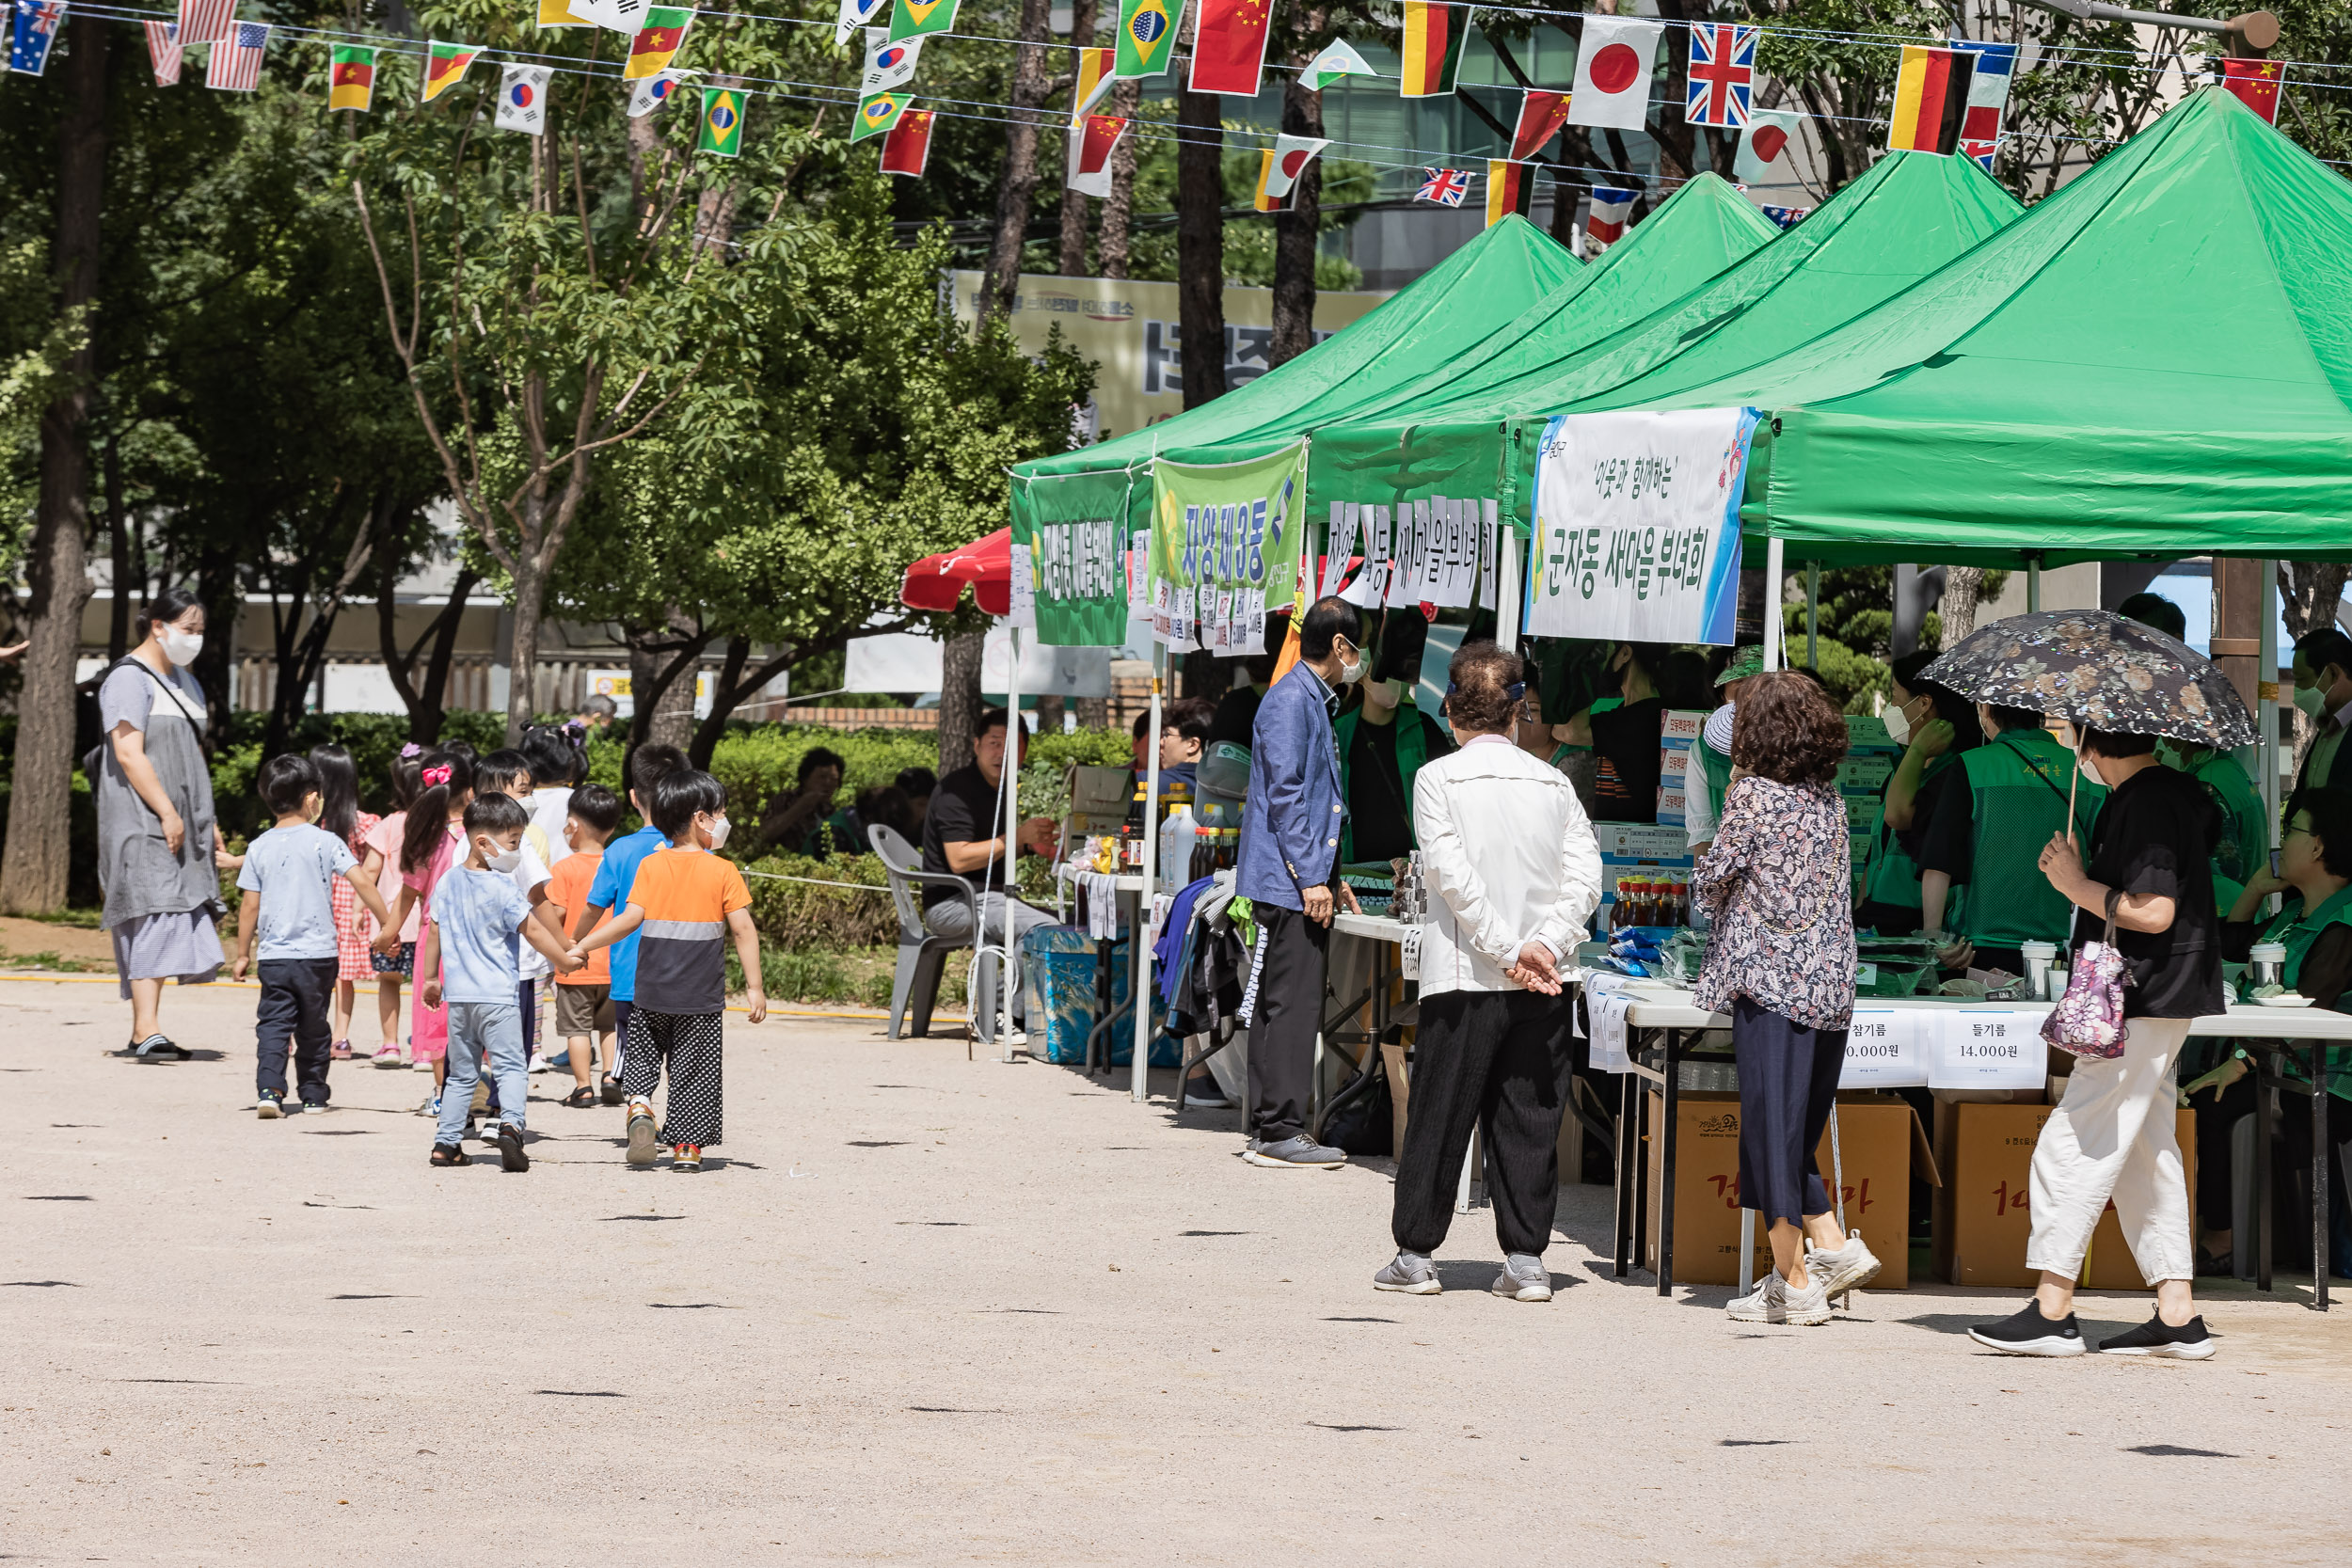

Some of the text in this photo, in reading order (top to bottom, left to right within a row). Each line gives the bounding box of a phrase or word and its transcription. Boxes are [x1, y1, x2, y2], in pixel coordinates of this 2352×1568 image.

[1182, 497, 1267, 585] 자양제3동
[1549, 528, 1601, 600] 군자동
[1852, 1023, 1887, 1037] 참기름
[1972, 1023, 2007, 1037] 들기름
[1846, 1044, 1899, 1058] 0,000원
[1707, 1172, 1875, 1214] 건마
[1718, 1245, 1740, 1254] 고향식
